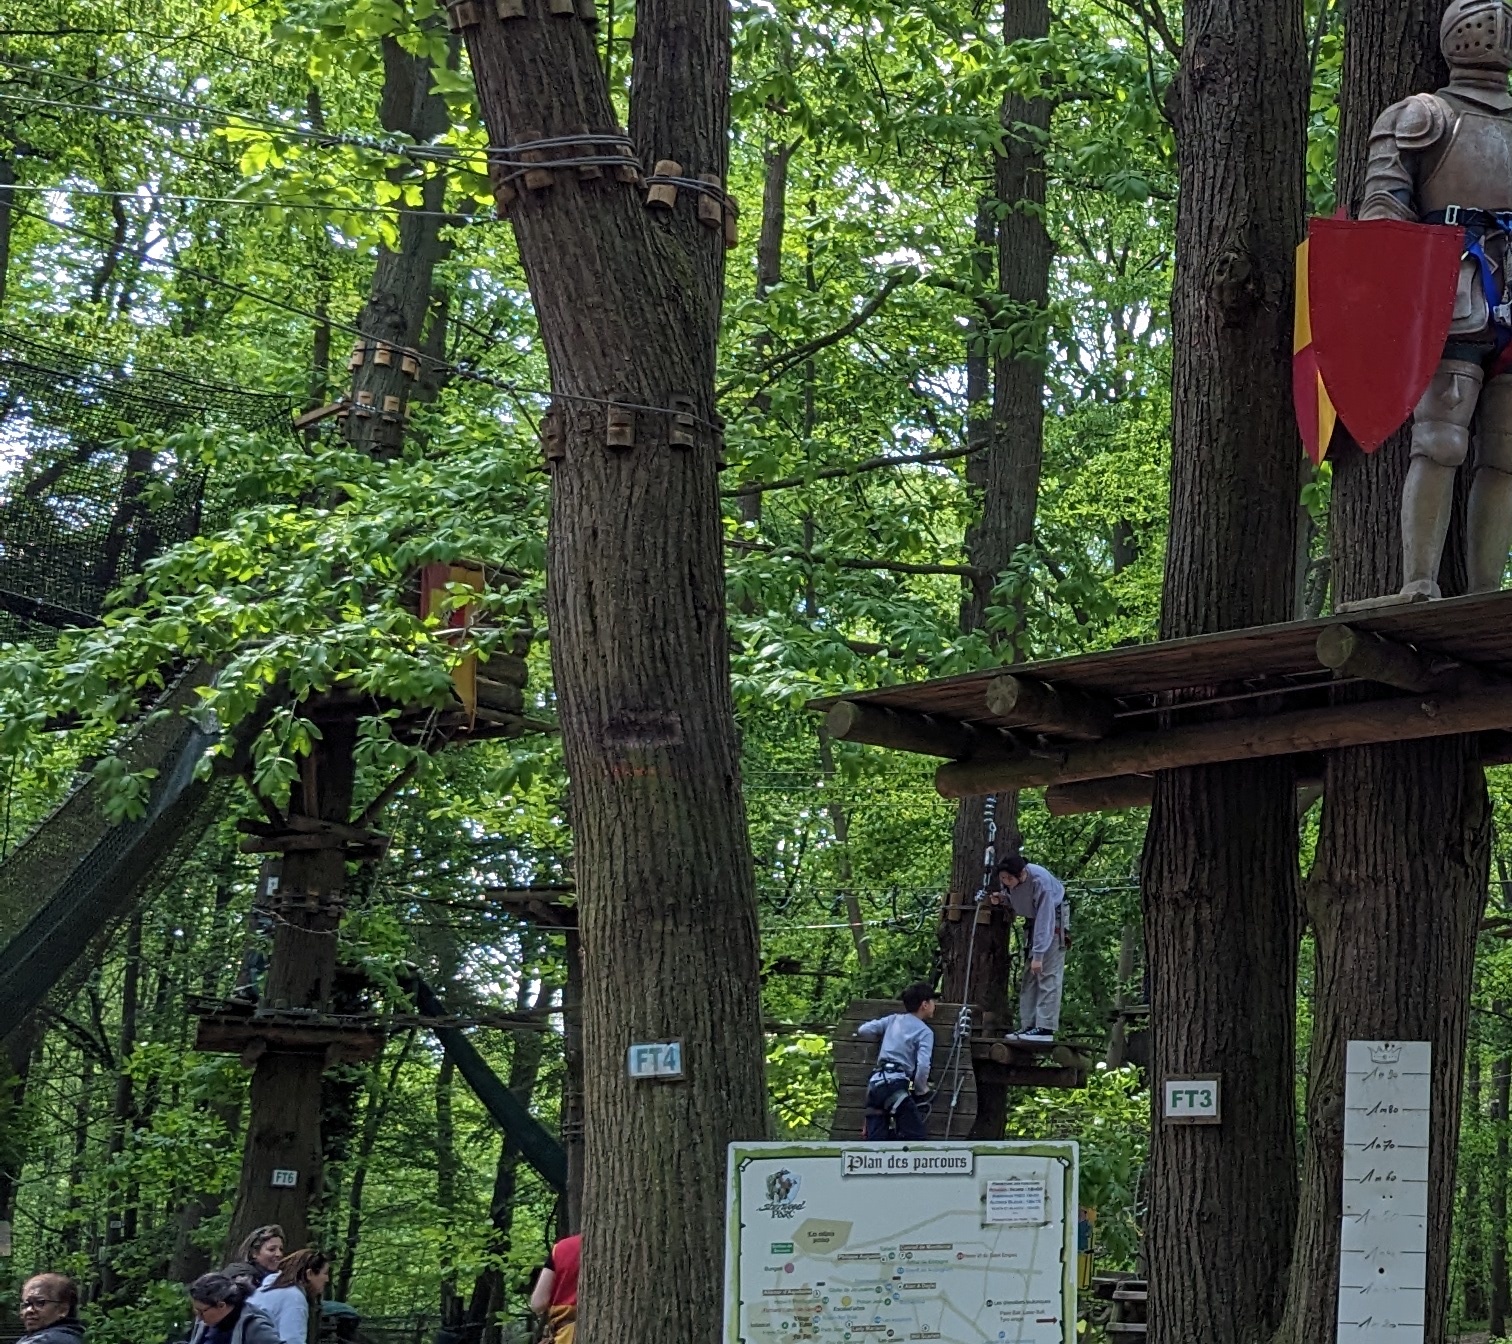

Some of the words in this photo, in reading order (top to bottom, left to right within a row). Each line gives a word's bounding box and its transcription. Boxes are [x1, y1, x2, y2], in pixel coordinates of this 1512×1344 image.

[636, 1047, 676, 1073] FT4
[1171, 1089, 1213, 1108] FT3
[847, 1155, 882, 1171] Plan
[888, 1155, 908, 1169] des
[913, 1156, 967, 1171] parcours
[276, 1171, 294, 1184] FT6
